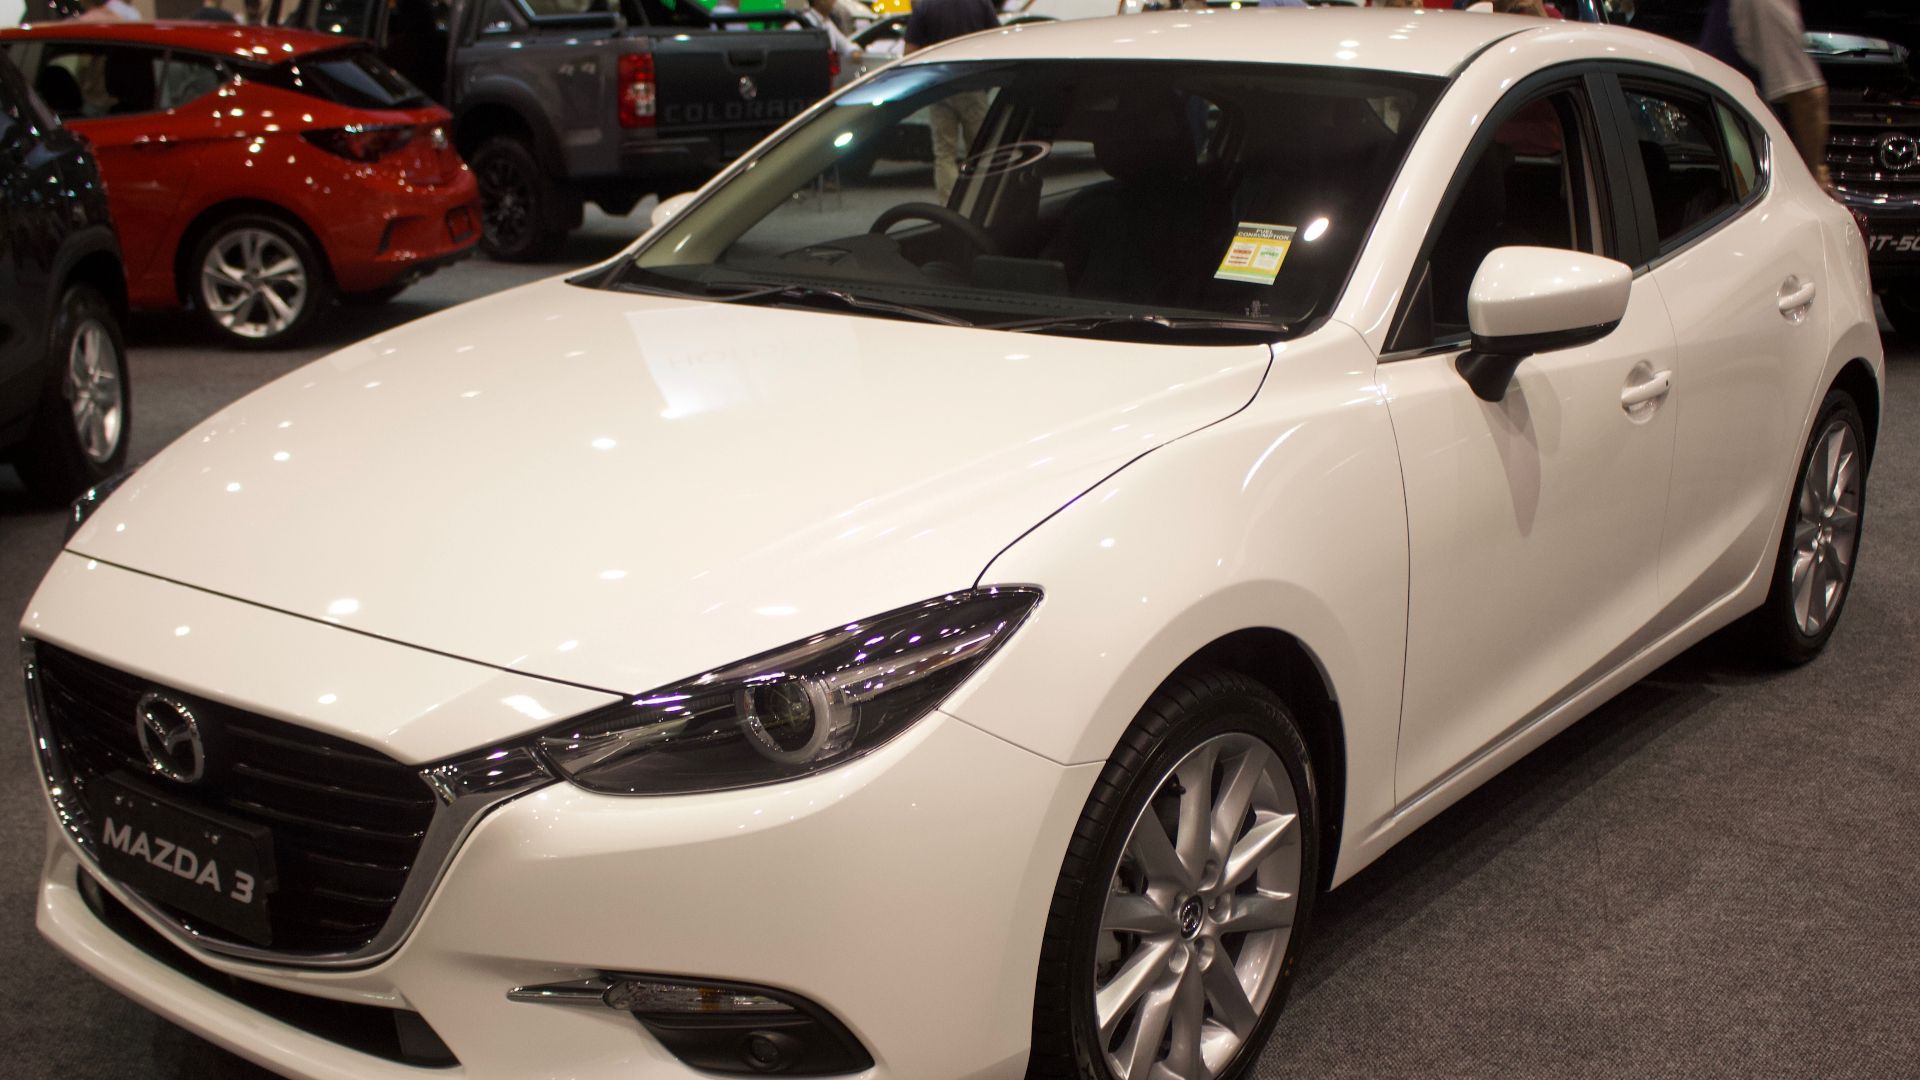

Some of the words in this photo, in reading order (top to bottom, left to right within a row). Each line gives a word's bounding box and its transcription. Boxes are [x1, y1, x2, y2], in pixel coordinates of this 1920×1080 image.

[664, 98, 815, 124] COLORAD
[1238, 231, 1290, 241] CONSUMPTION
[102, 816, 222, 893] MAZDA
[230, 869, 255, 904] 3
